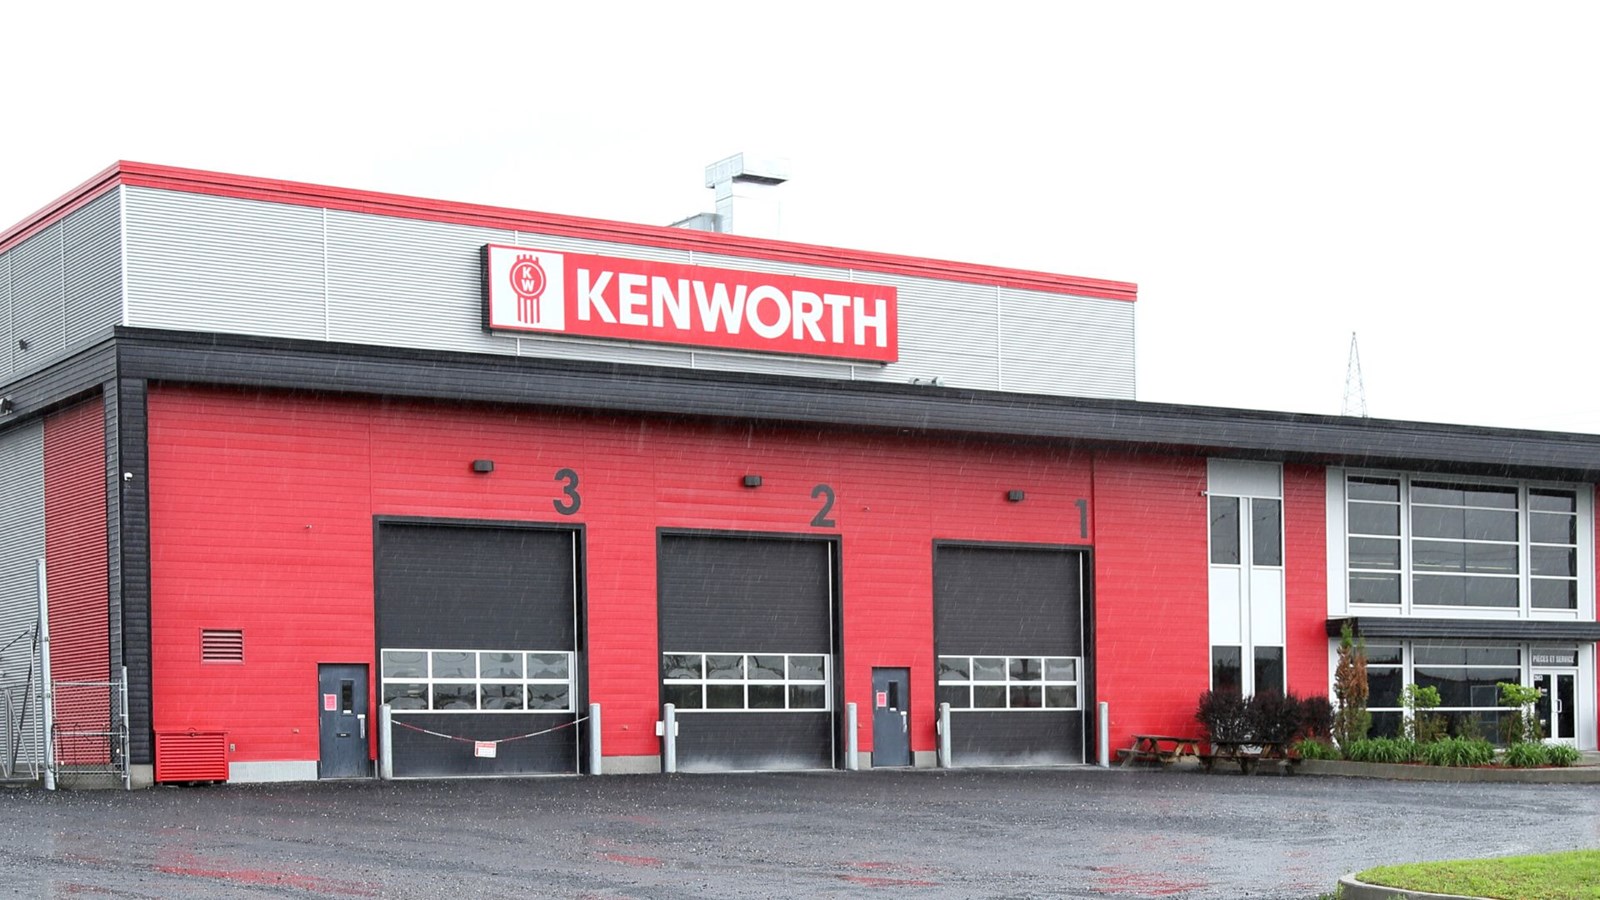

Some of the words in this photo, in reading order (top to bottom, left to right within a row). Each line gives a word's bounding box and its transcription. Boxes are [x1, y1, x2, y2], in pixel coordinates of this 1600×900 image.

[521, 279, 535, 292] W
[522, 266, 533, 279] K
[576, 268, 888, 348] KENWORTH
[553, 468, 581, 516] 3
[810, 483, 836, 528] 2
[1074, 498, 1088, 539] 1
